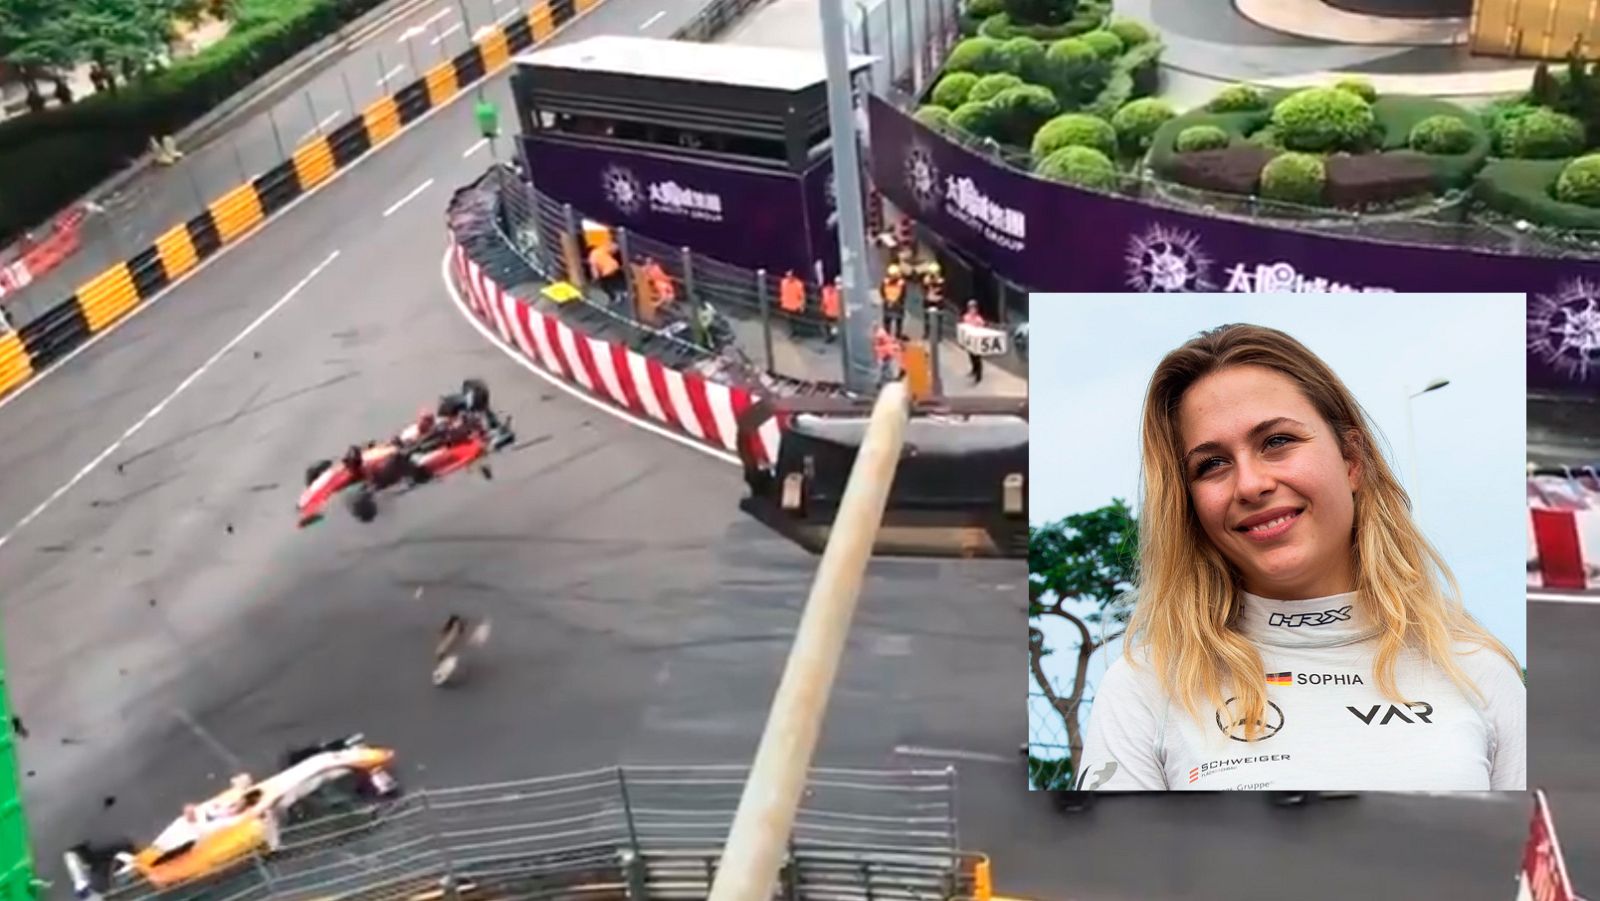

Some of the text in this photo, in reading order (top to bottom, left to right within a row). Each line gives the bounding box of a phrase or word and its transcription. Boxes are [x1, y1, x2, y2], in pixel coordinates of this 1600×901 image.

[1268, 605, 1353, 628] HRX
[1297, 673, 1364, 685] SOPHIA
[1345, 701, 1434, 726] VAR
[1201, 754, 1291, 772] SCHWEIGER
